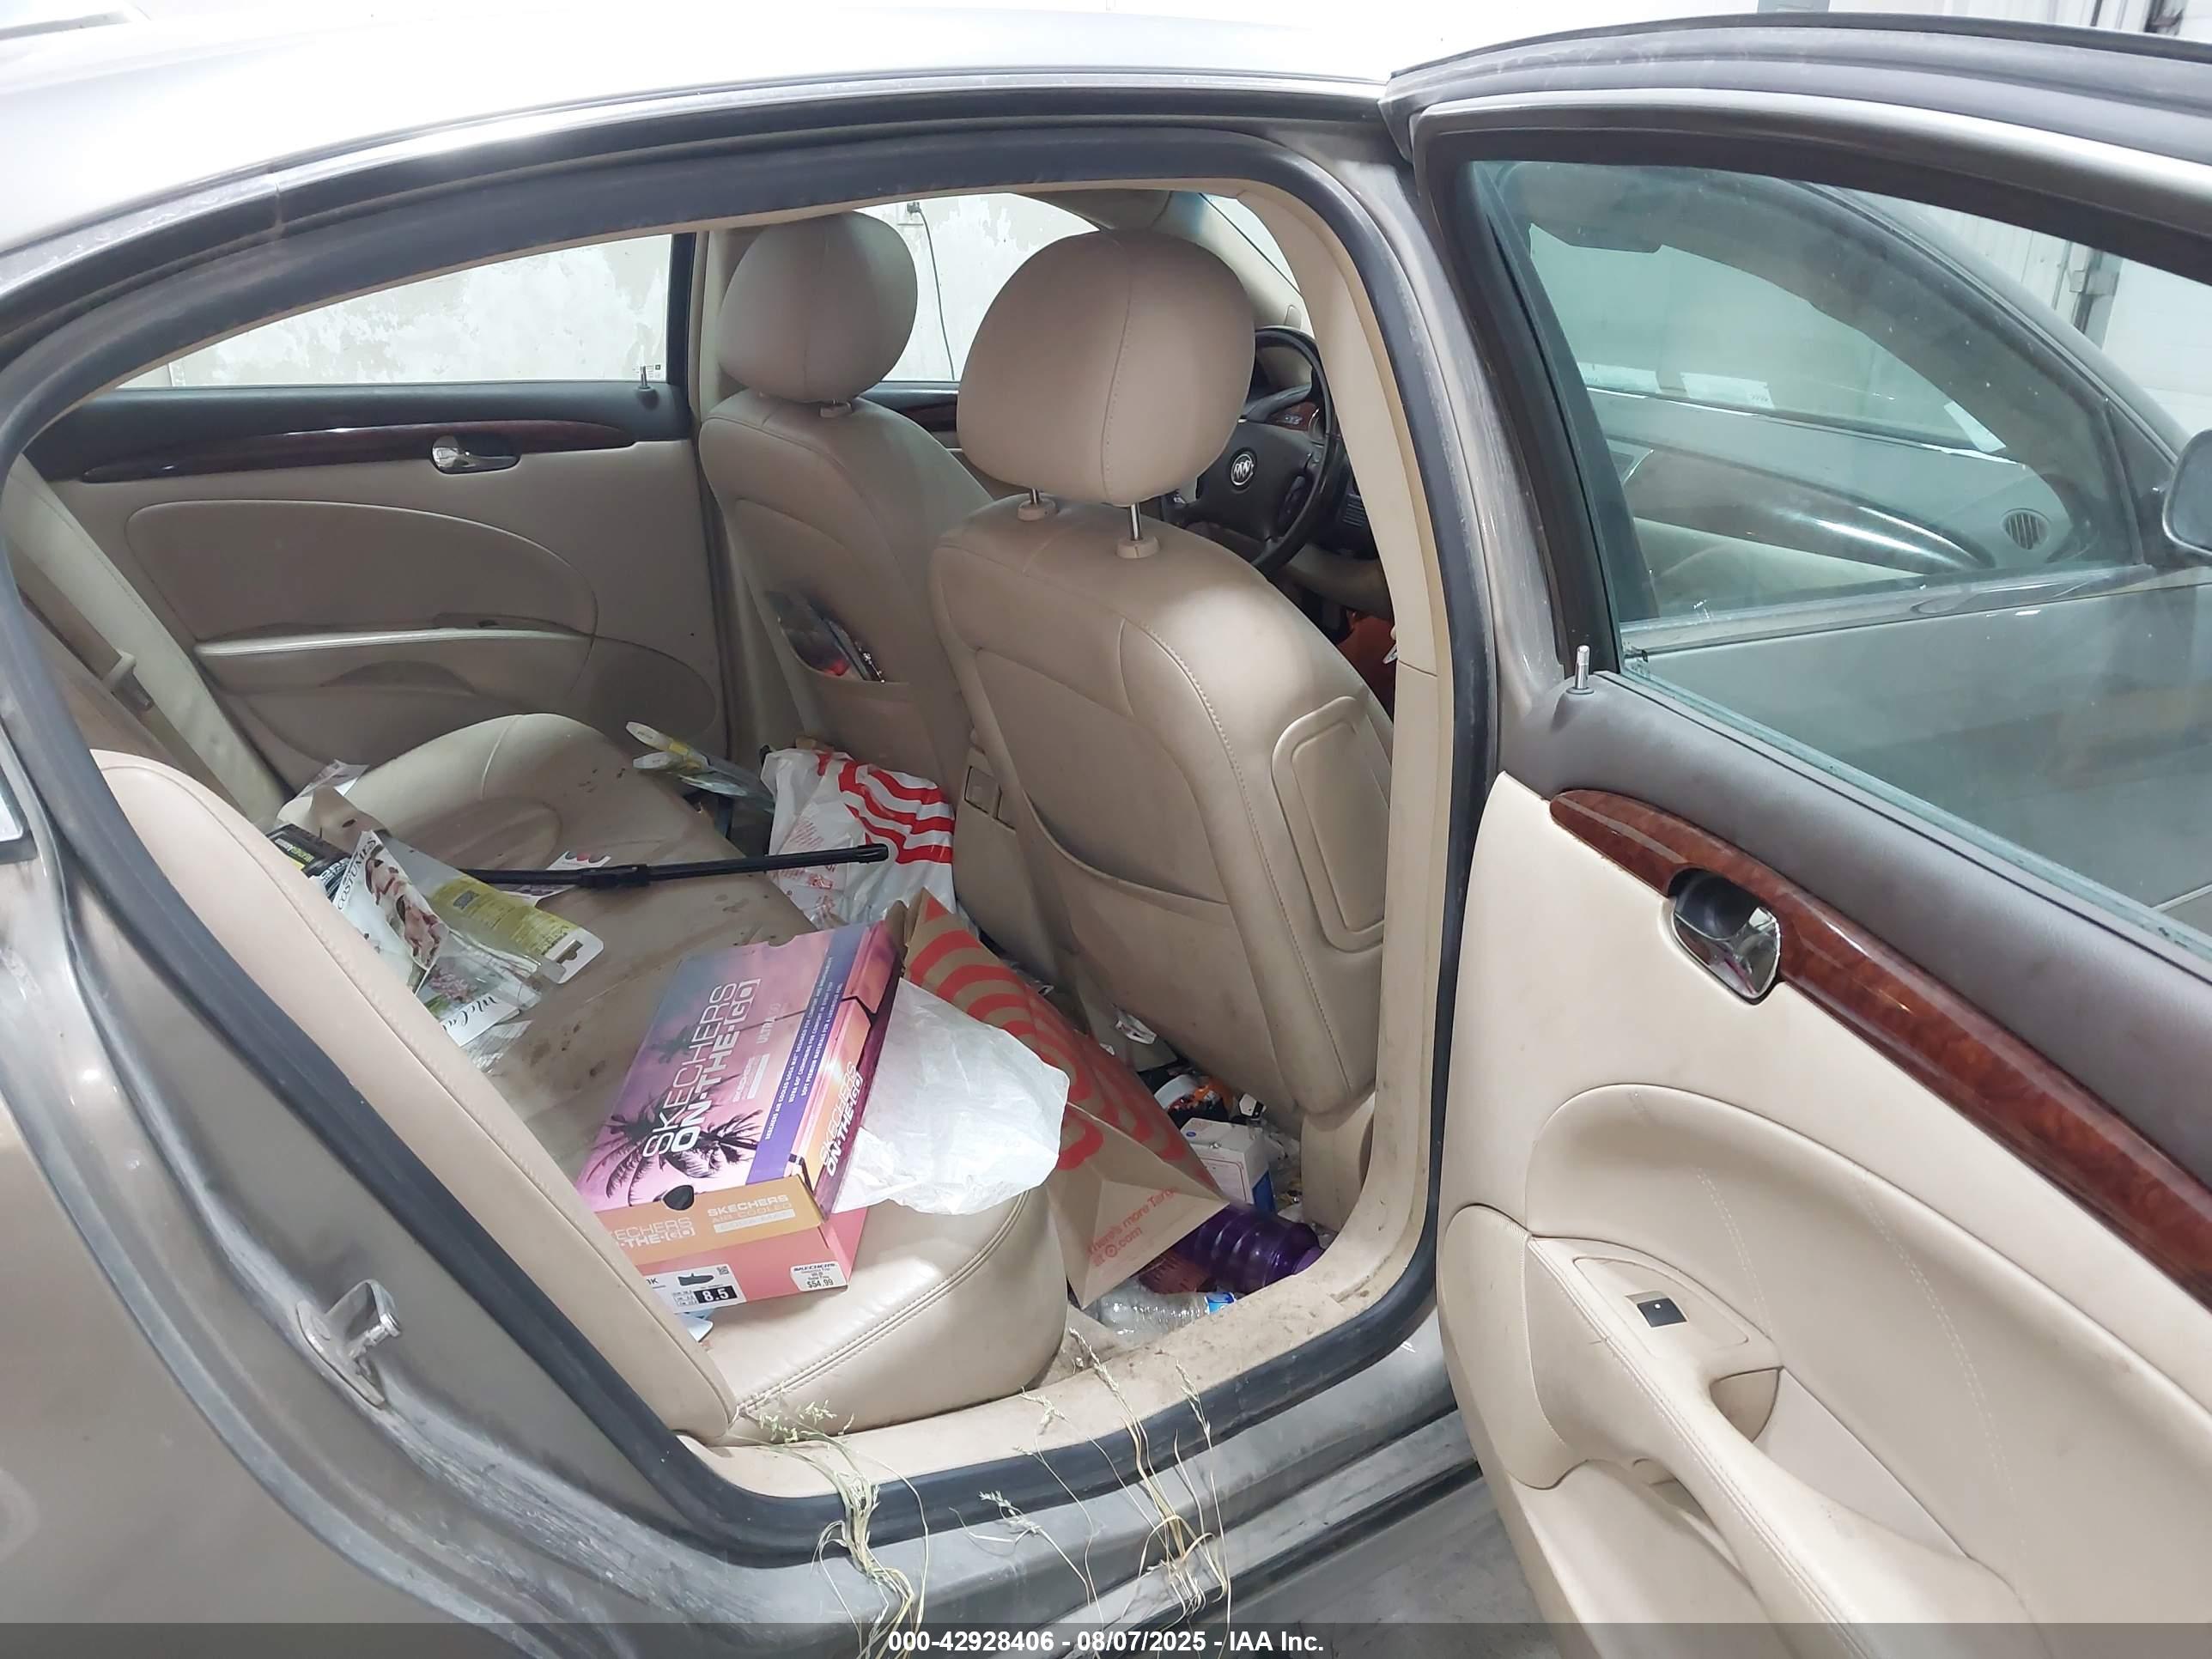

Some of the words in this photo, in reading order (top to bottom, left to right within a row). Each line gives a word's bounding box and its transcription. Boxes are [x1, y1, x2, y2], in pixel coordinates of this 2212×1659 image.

[643, 982, 737, 1157] SKECHERS
[778, 1081, 789, 1102] COOLED
[820, 1061, 857, 1165] SKECHERS
[708, 1194, 789, 1217] SKECHERS
[612, 1217, 693, 1241] ECHERS
[702, 1288, 729, 1302] 8.5
[807, 1279, 835, 1288] $54.99
